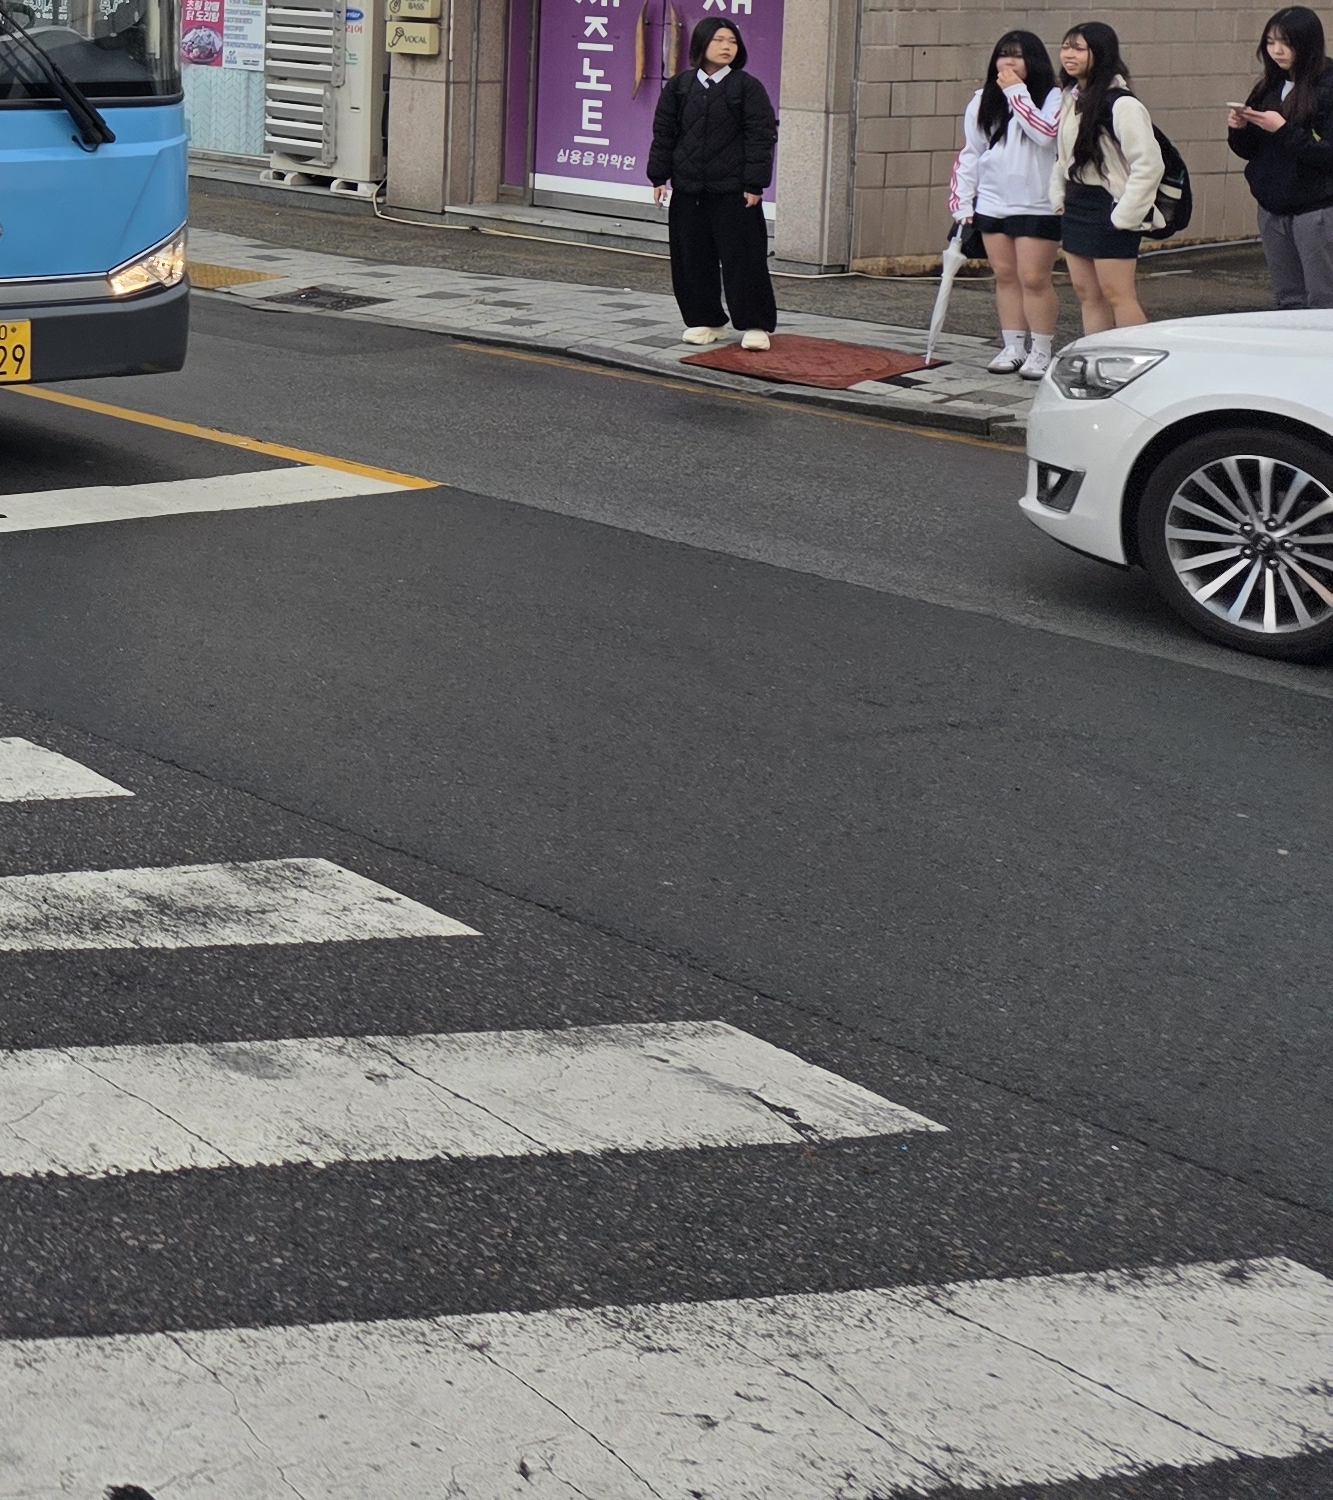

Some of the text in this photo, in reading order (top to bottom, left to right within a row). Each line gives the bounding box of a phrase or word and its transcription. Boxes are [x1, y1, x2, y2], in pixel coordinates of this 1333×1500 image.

[408, 2, 425, 10] BASS
[345, 24, 363, 34] 리어
[404, 35, 427, 44] VOCAL
[556, 148, 636, 171] 실용음악학원
